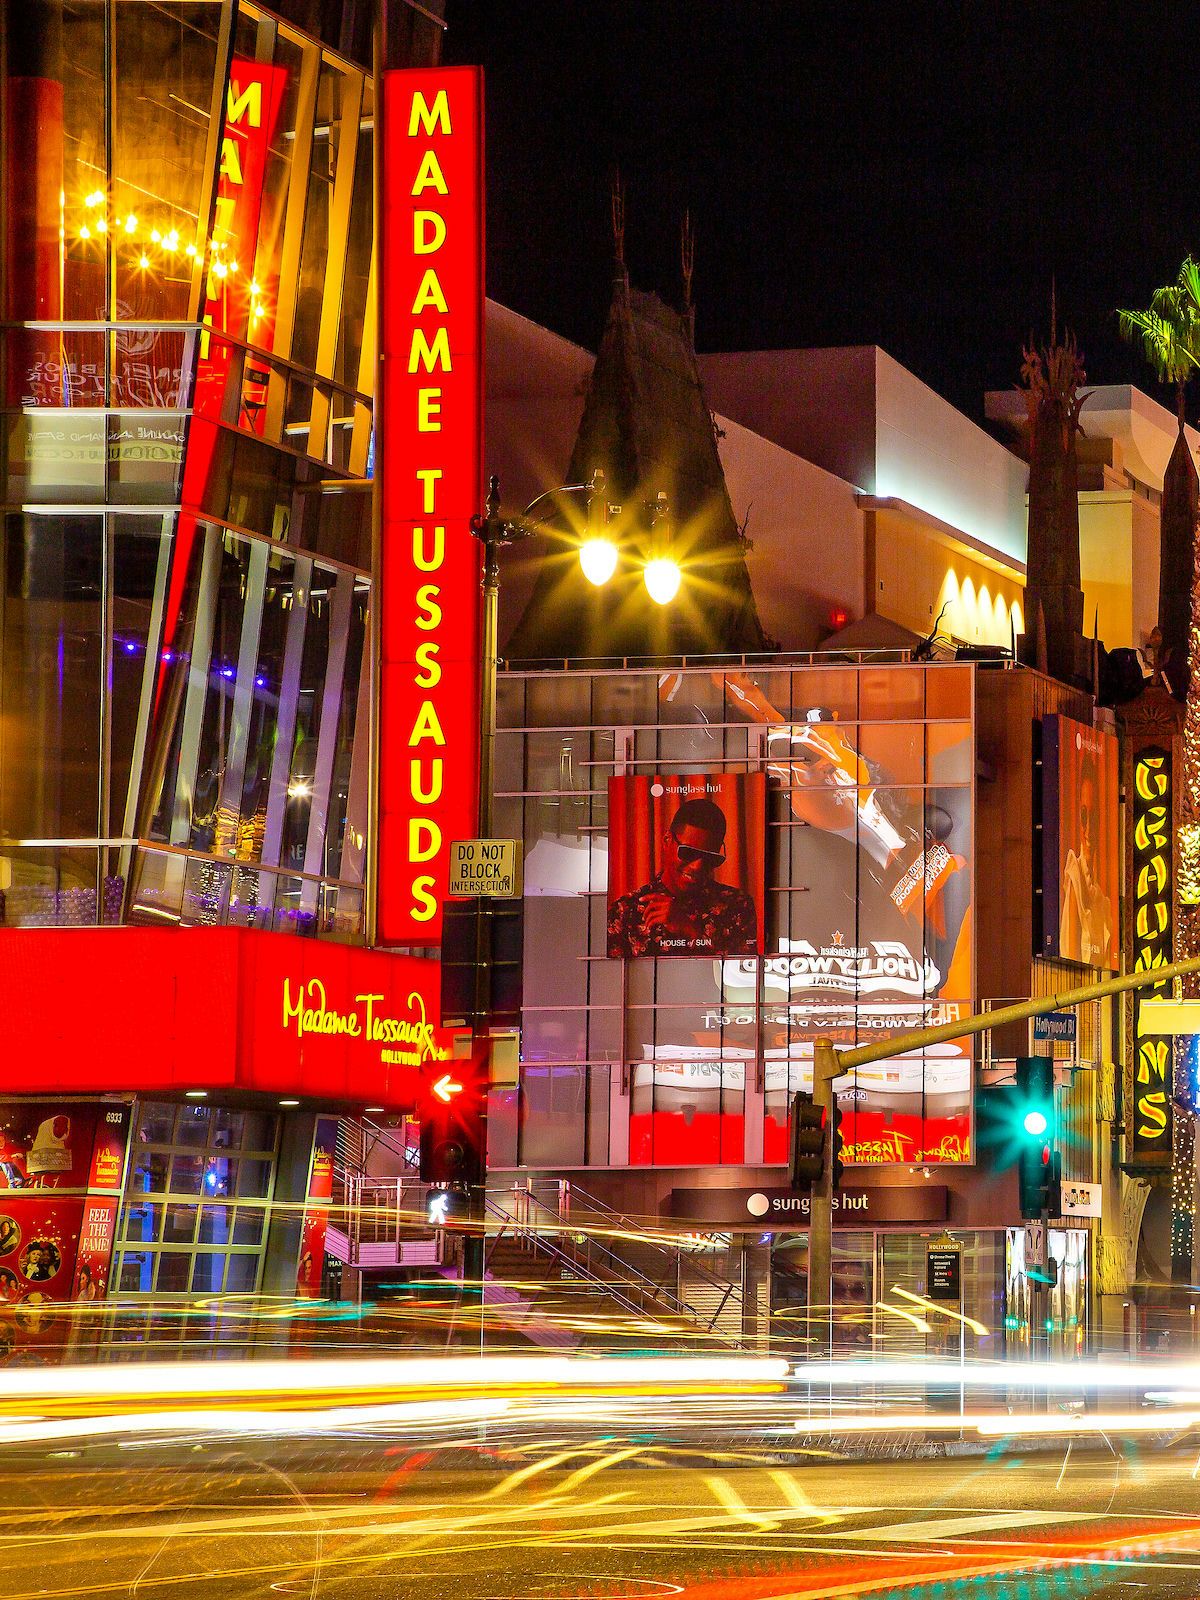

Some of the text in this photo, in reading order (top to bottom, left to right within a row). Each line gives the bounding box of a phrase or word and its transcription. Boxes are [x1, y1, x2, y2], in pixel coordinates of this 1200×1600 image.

[407, 89, 453, 923] MADAME TUSSAUDS
[665, 783, 722, 796] sunglass hut
[458, 844, 506, 860] DO NOT
[460, 863, 501, 878] BLOCK
[451, 880, 510, 892] INTERSECTION
[659, 939, 686, 947] HOUSE
[695, 939, 711, 947] SUN
[1134, 755, 1169, 1139] GRAUMNS
[282, 977, 436, 1062] Madame Tussauds
[1036, 1016, 1068, 1037] Hollywood
[381, 1049, 421, 1067] HOLLYWOOD
[106, 1112, 123, 1124] 6933
[96, 1148, 120, 1163] Madame
[95, 1163, 119, 1176] Tussauds
[772, 1193, 869, 1215] sungs hut
[88, 1208, 112, 1222] FEEL
[89, 1224, 108, 1236] THE
[82, 1238, 110, 1251] FAME!
